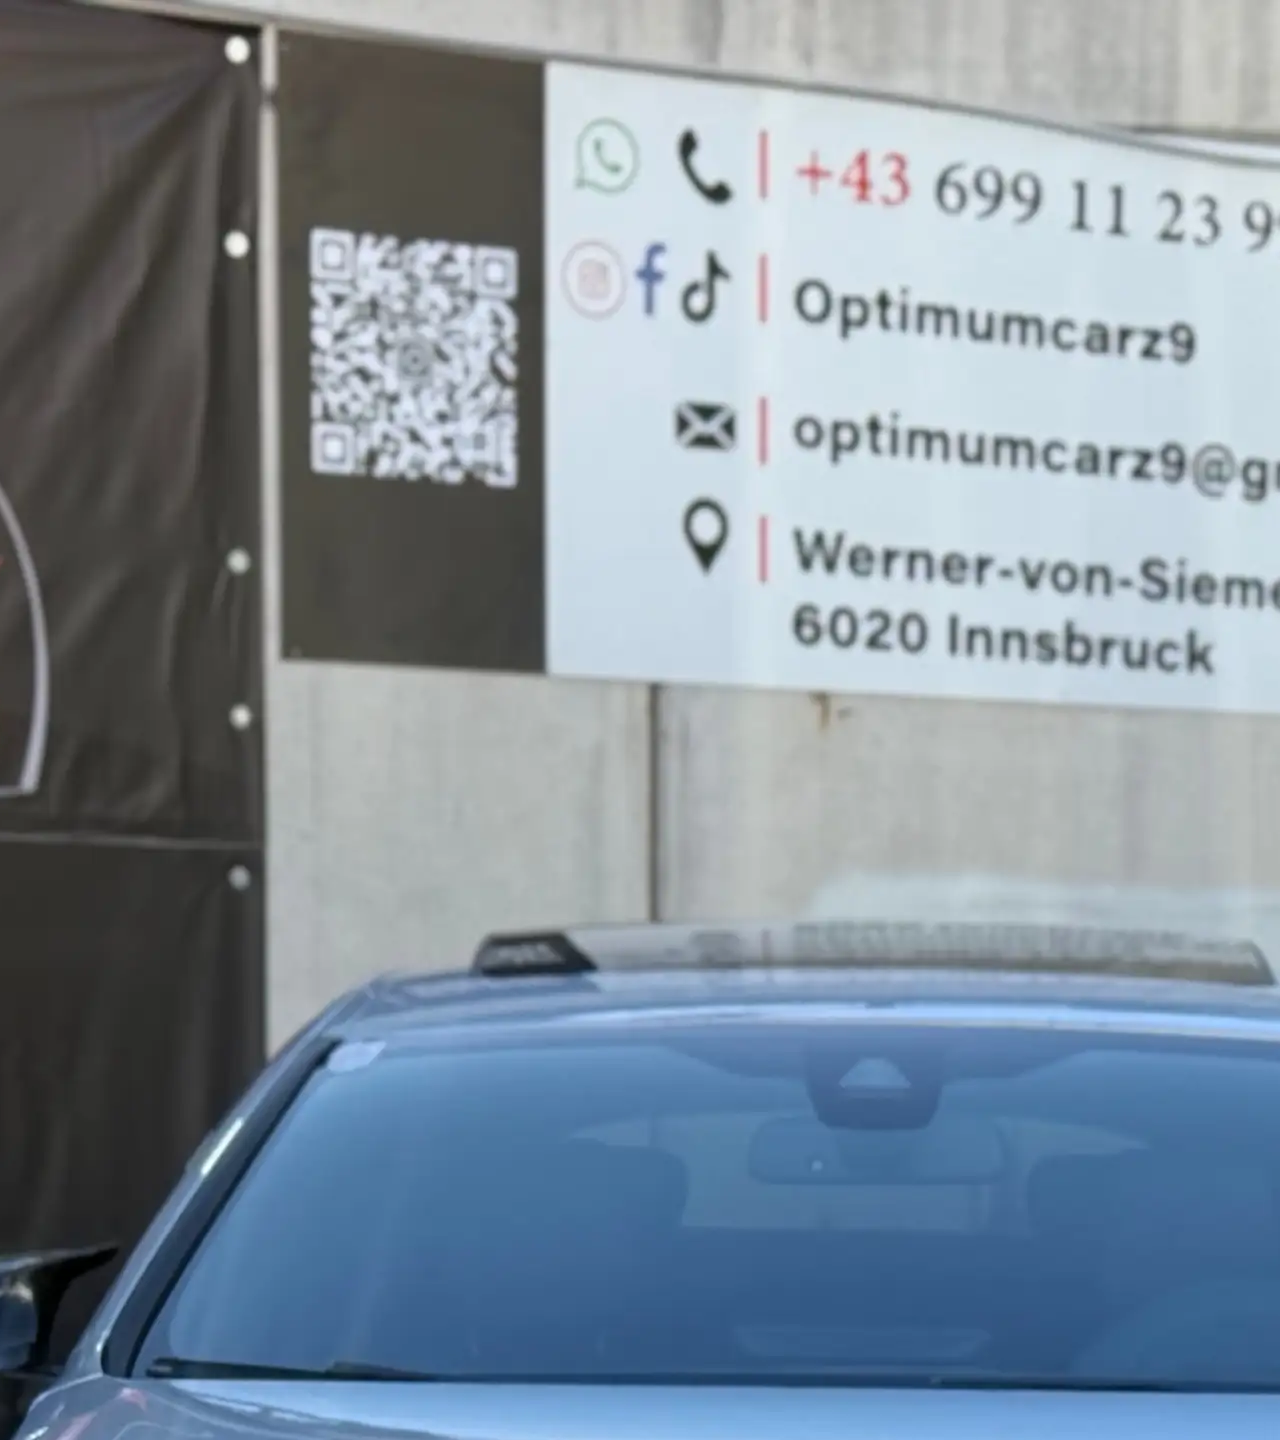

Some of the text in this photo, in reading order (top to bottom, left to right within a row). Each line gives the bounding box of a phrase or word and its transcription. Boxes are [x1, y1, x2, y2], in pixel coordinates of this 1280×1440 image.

[796, 149, 912, 206] +43
[934, 164, 1043, 223] 699
[1072, 180, 1128, 237] 11
[1157, 190, 1222, 246] 23
[794, 279, 1197, 364] Optimumcarz9
[792, 603, 1215, 675] 6020 Innsbruck
